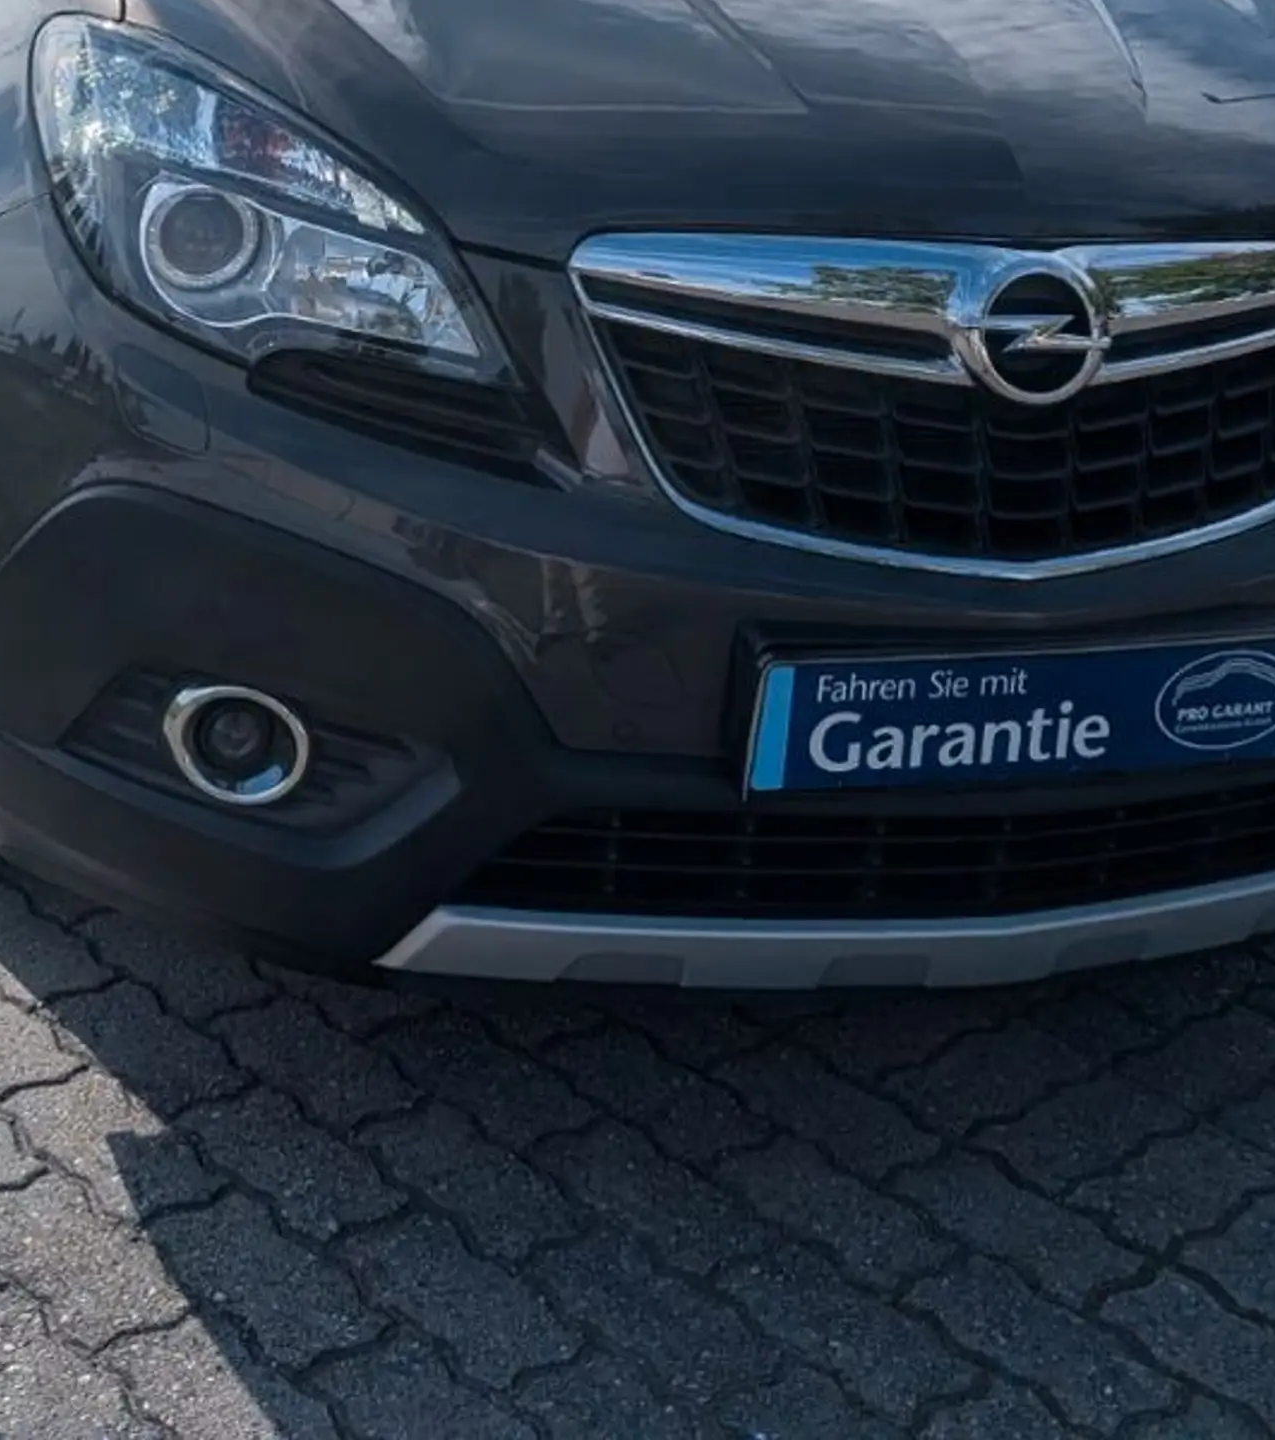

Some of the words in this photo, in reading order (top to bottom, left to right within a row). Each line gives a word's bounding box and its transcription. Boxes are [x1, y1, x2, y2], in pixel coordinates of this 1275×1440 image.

[816, 673, 916, 702] Fahren
[928, 669, 969, 699] Sie
[979, 667, 1028, 695] mit
[1178, 707, 1209, 721] PRO
[809, 700, 1110, 772] Garantie
